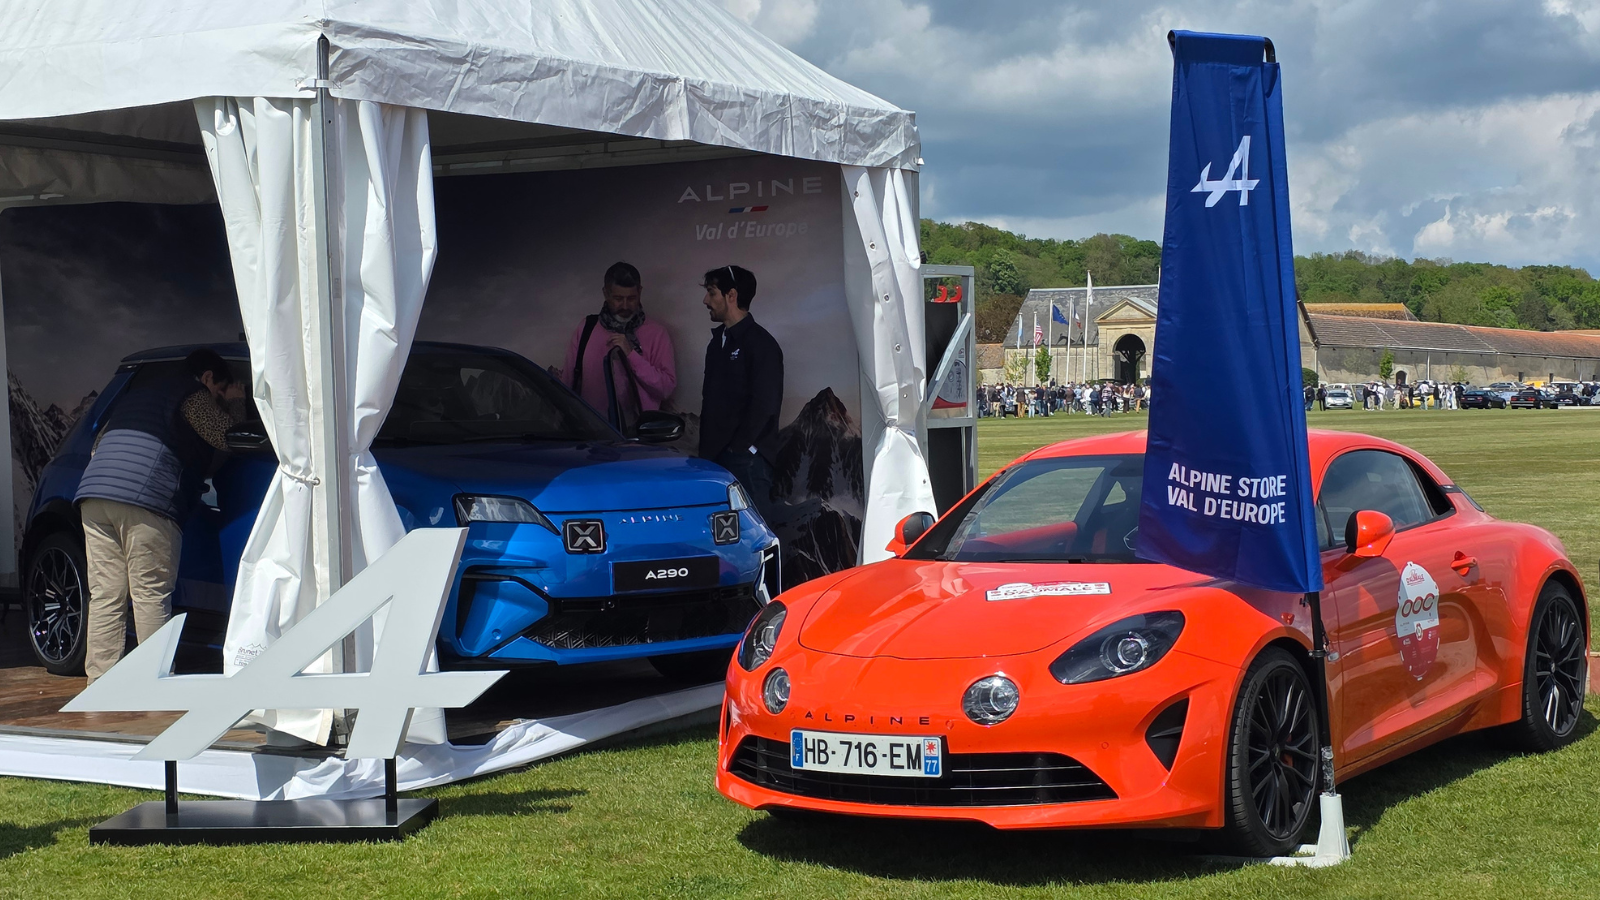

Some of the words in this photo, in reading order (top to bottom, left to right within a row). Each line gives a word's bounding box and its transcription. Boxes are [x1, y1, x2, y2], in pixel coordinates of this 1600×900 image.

[677, 176, 822, 203] ALPINE
[695, 222, 724, 241] Val
[728, 221, 809, 240] d'Europe
[1168, 462, 1232, 494] ALPINE
[1237, 475, 1286, 498] STORE
[1167, 485, 1198, 512] VAL
[1204, 497, 1285, 524] D'EUROPE
[619, 514, 684, 524] ALPINE
[645, 567, 689, 580] A290
[805, 711, 930, 725] ALPINE
[804, 737, 922, 770] HB-716-EM
[925, 759, 938, 773] 77
